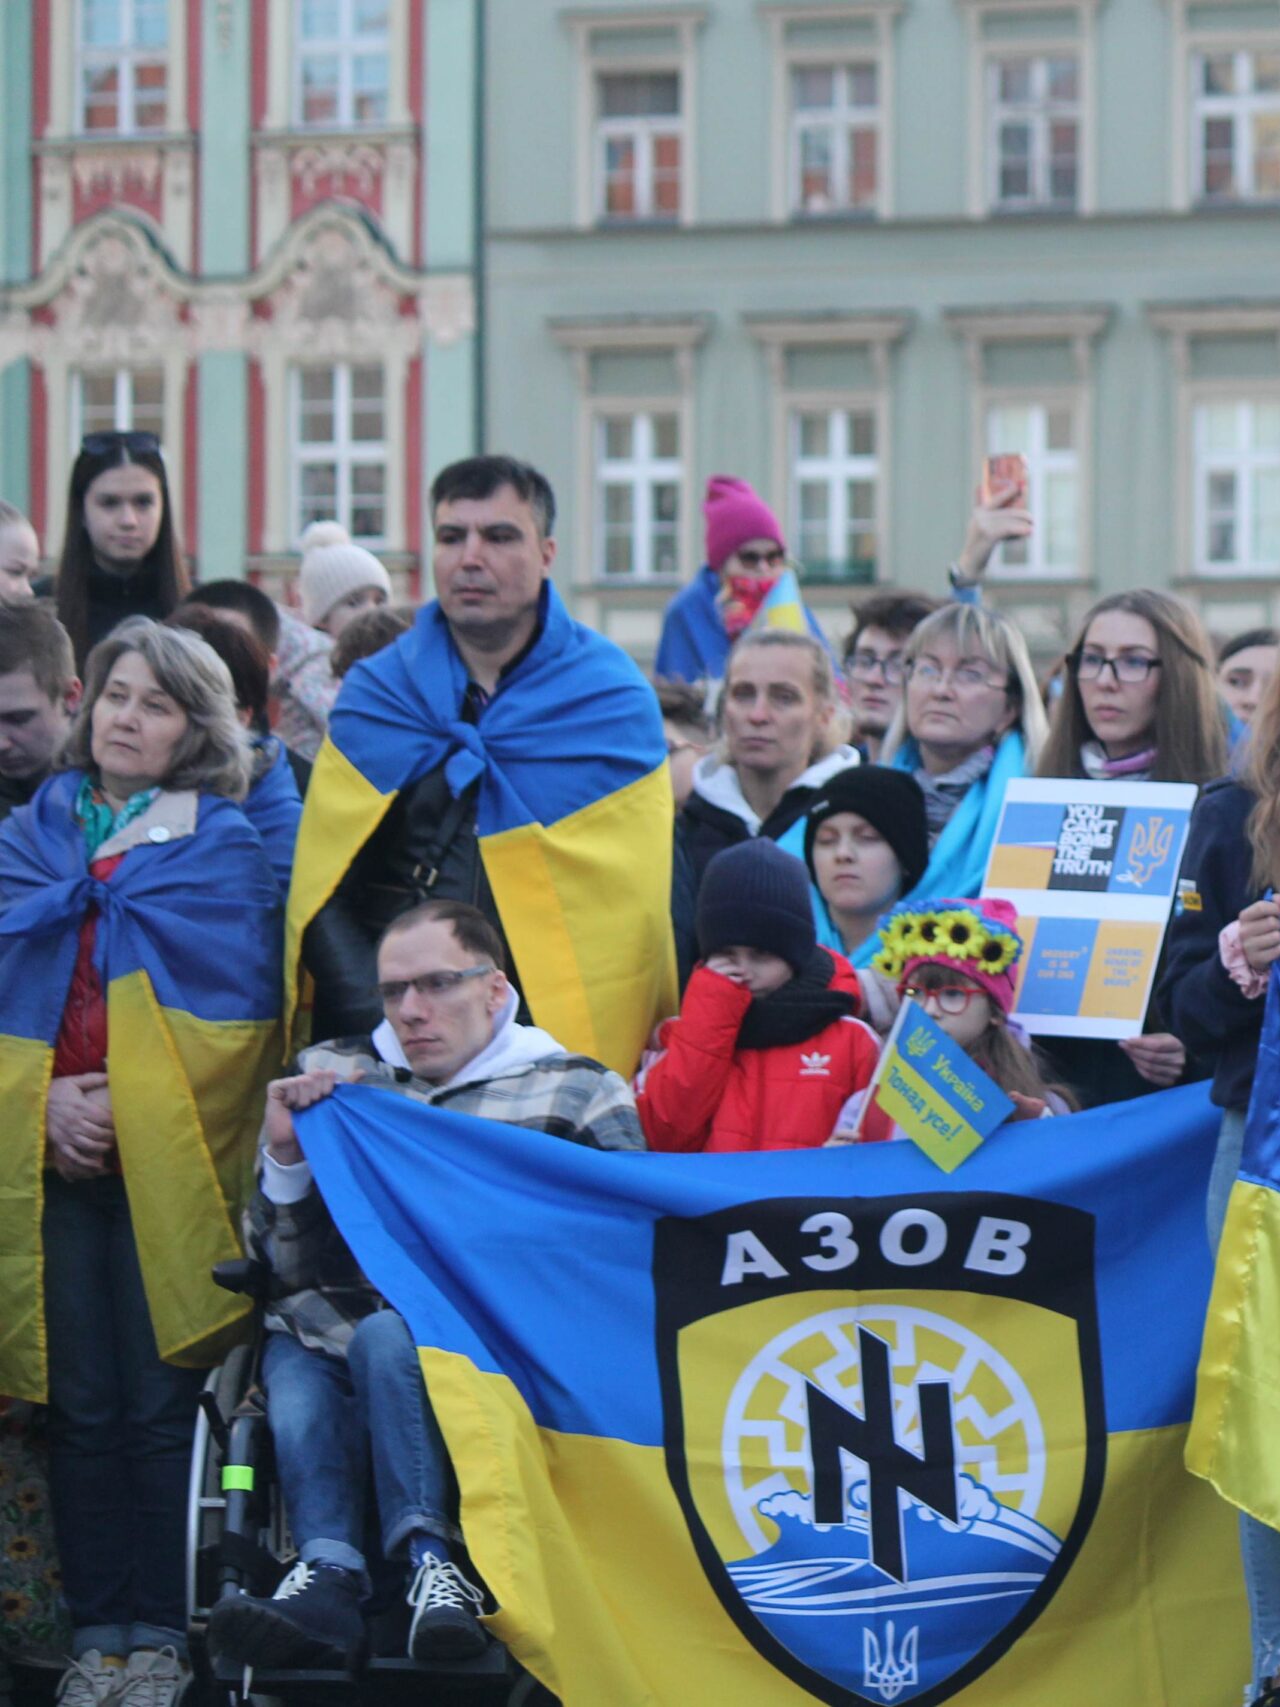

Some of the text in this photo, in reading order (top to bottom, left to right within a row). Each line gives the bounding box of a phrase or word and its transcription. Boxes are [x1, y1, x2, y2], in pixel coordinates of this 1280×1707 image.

[1067, 804, 1105, 820] YOU
[1060, 832, 1113, 849] BOMB
[1057, 845, 1093, 861] THE
[1054, 859, 1113, 876] TRUTH
[931, 1053, 985, 1113] Україна
[720, 1207, 1032, 1287] АЗОВ
